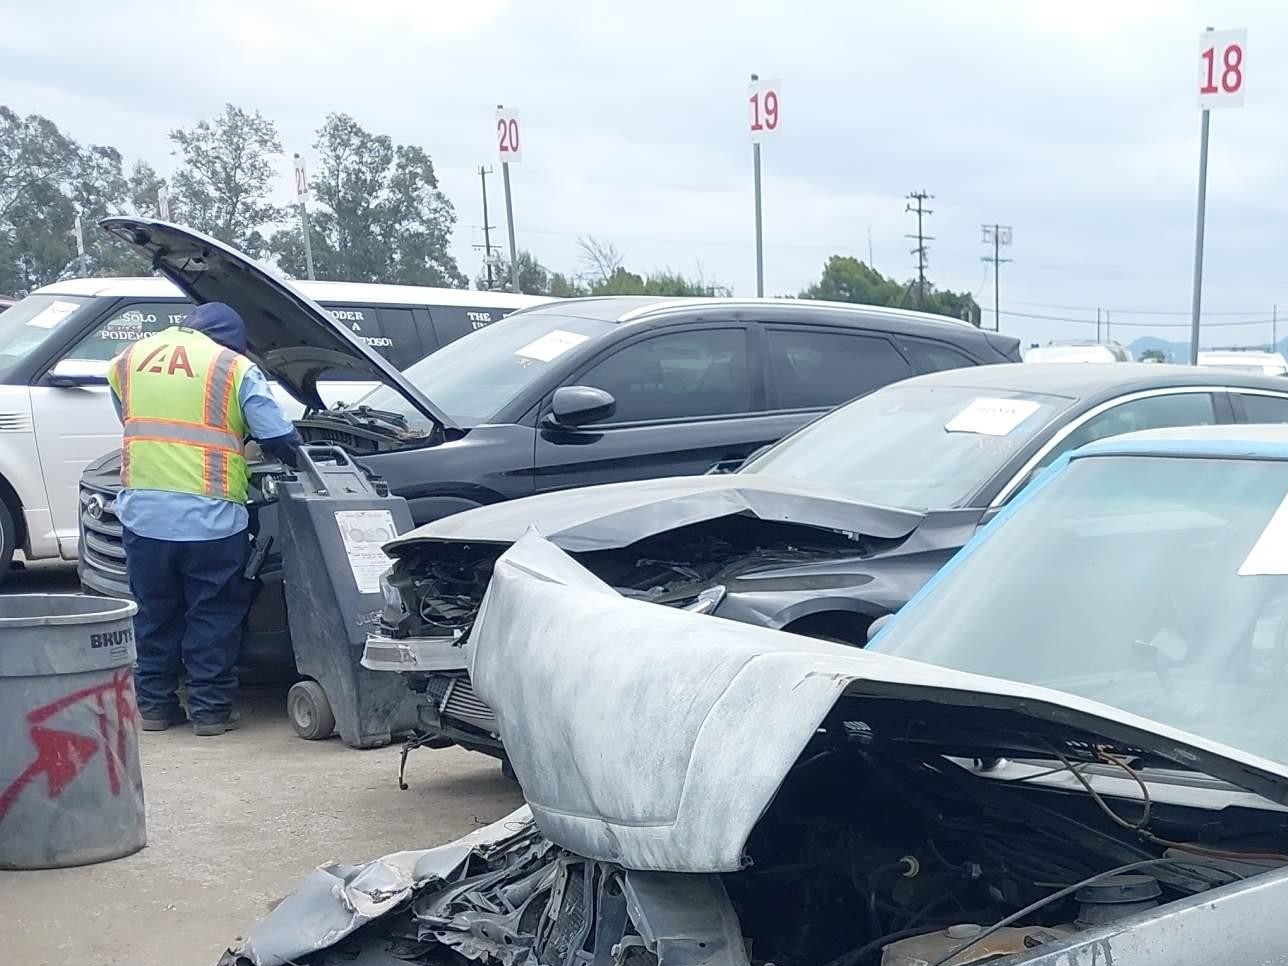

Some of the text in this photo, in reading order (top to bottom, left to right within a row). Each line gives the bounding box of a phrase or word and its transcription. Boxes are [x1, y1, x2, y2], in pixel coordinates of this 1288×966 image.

[1201, 45, 1242, 93] 18
[750, 91, 778, 130] 19
[497, 118, 519, 152] 20
[295, 167, 308, 195] 21
[122, 314, 157, 323] SOLO
[352, 322, 361, 331] A
[467, 312, 491, 322] THE
[90, 629, 133, 649] BRUTE
